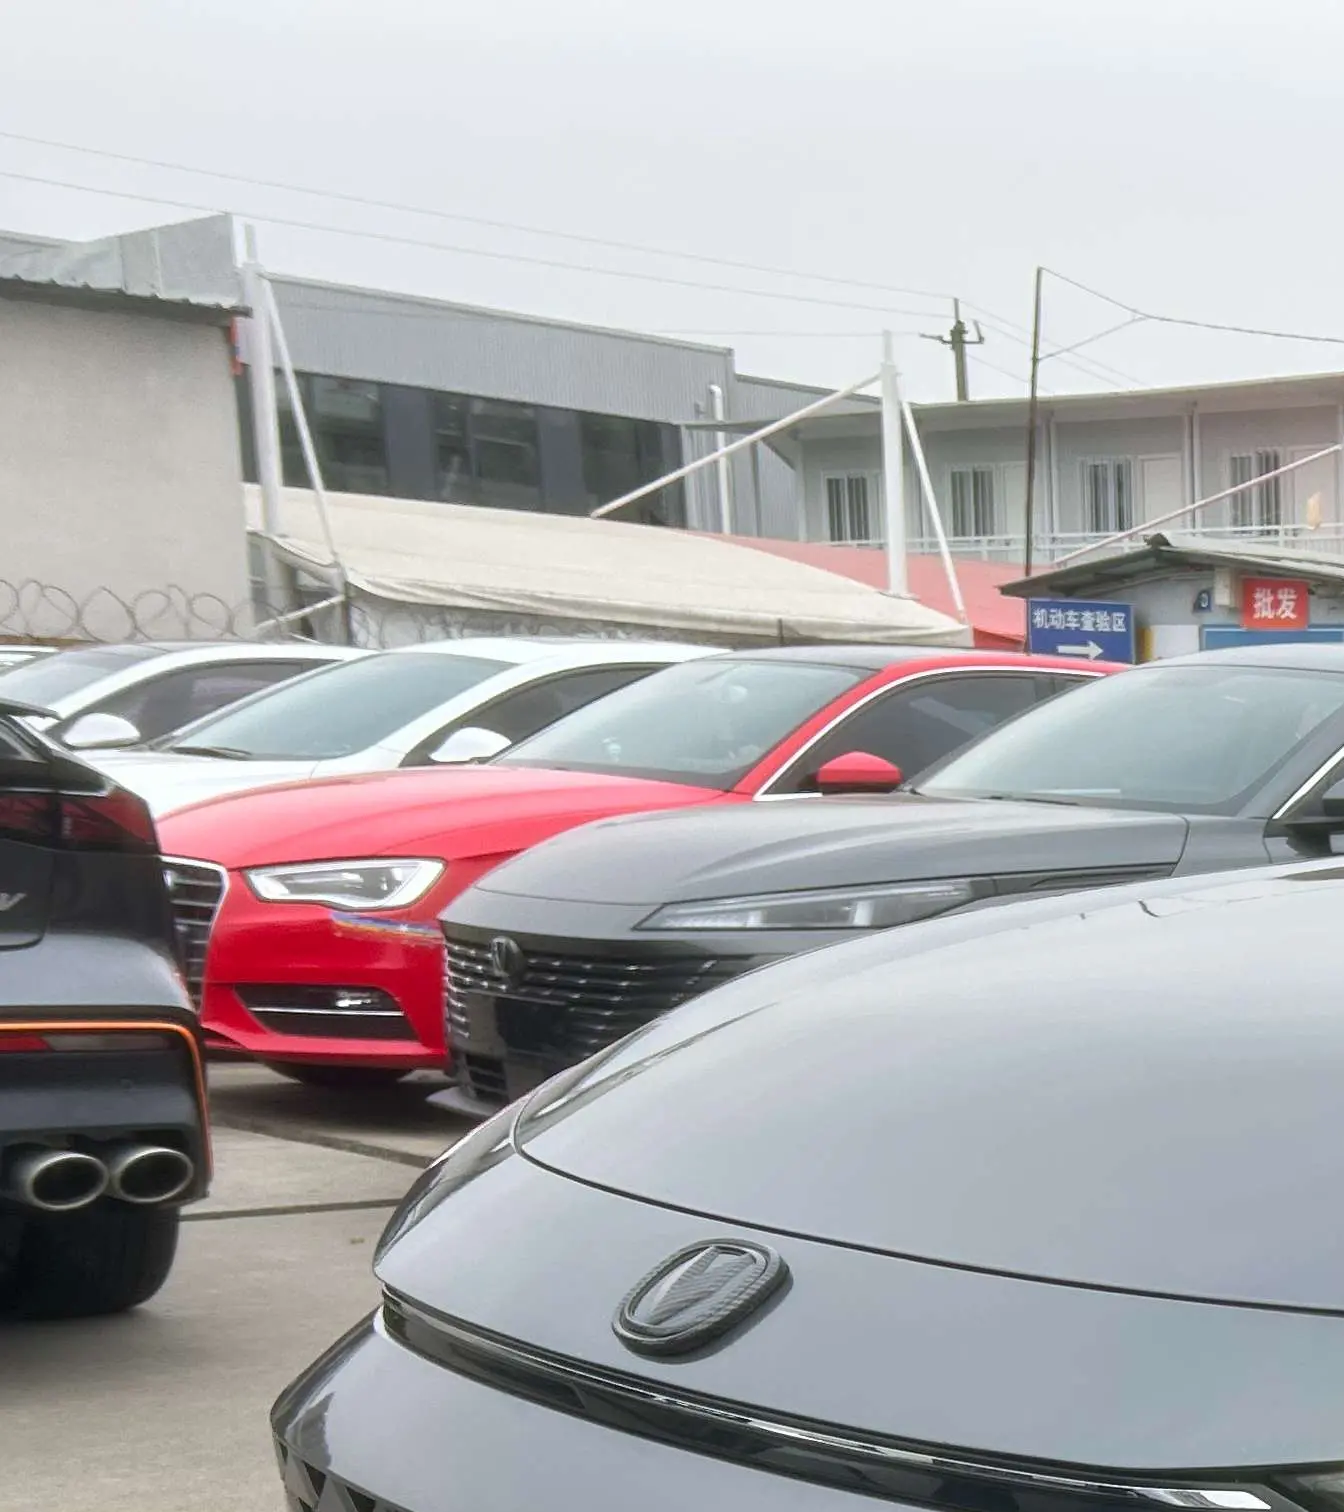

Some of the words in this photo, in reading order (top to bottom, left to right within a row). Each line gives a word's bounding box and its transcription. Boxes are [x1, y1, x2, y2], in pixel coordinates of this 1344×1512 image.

[1253, 588, 1298, 619] 批发
[1031, 608, 1127, 632] 机动车查验区
